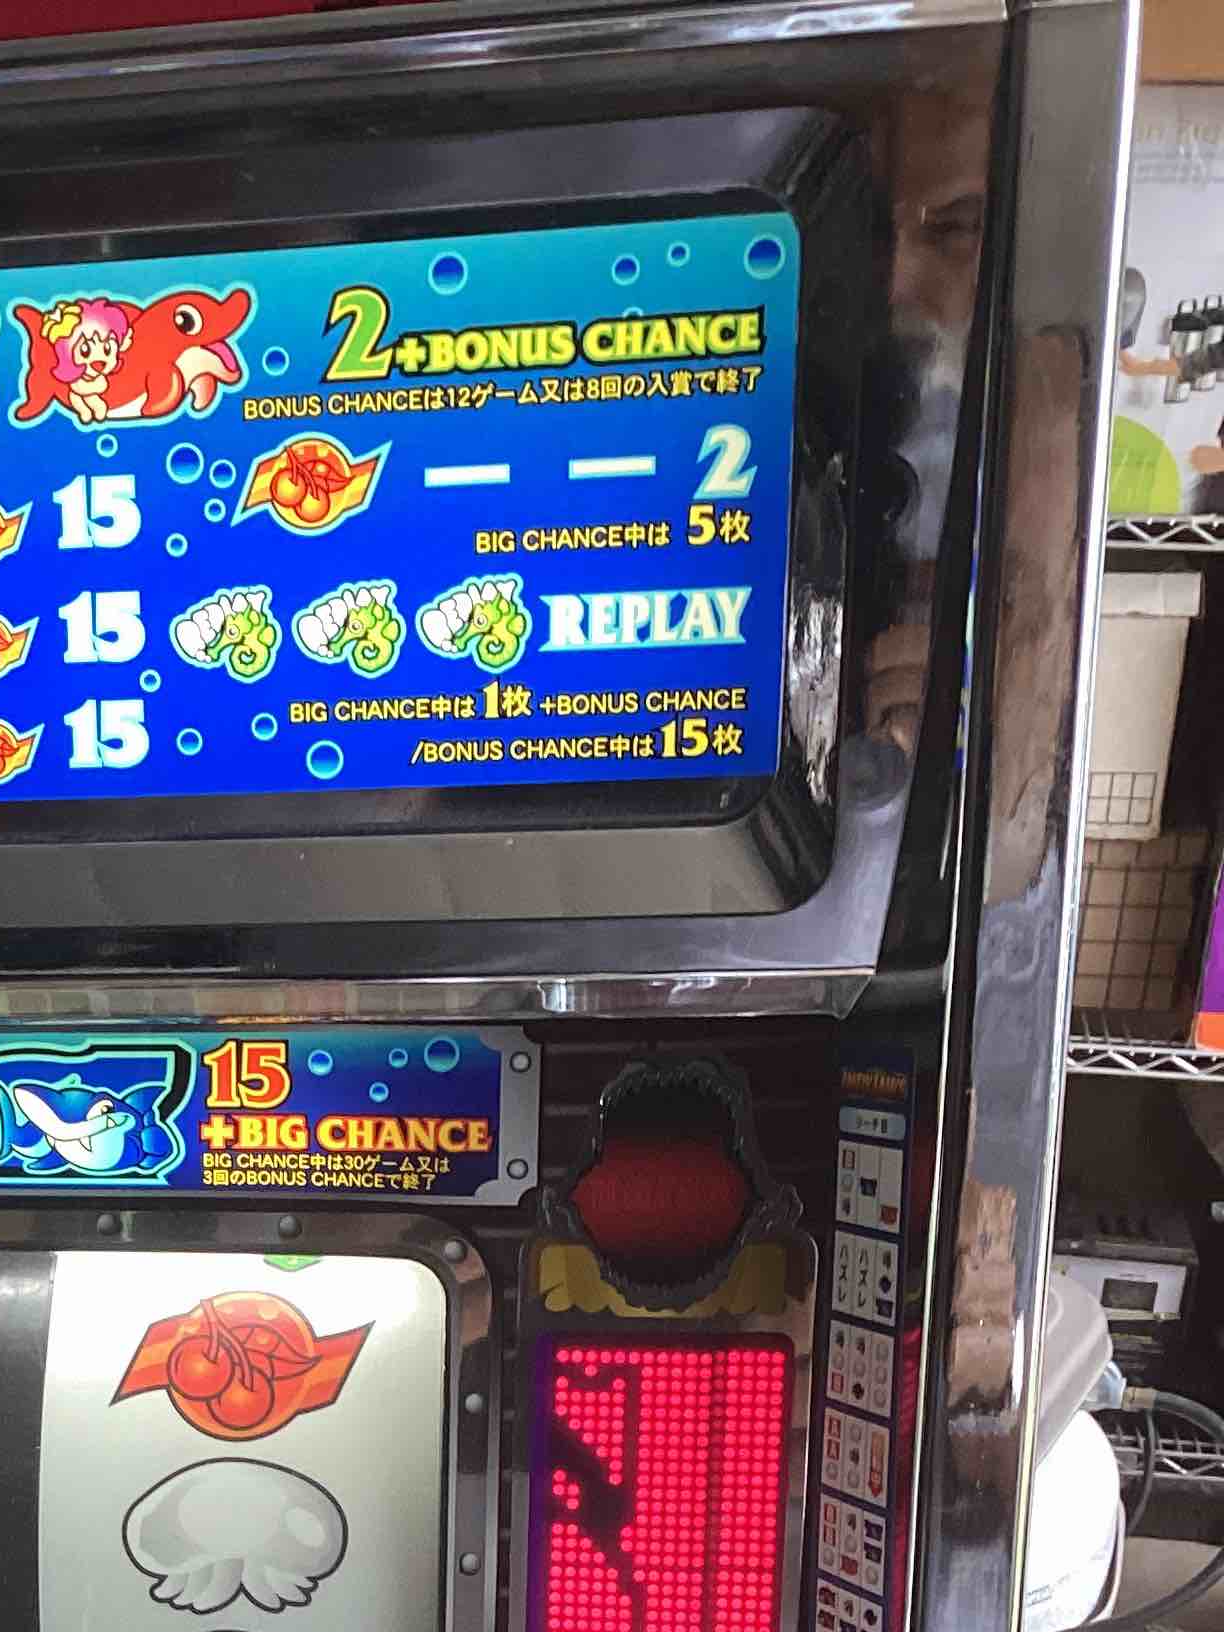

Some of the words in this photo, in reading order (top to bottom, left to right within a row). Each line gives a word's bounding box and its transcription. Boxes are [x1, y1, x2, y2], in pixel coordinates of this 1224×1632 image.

[321, 284, 392, 382] 2
[582, 308, 765, 365] CHANCE
[244, 394, 321, 420] BONUS
[694, 423, 758, 499] 2
[53, 475, 140, 549] 15
[476, 531, 515, 554] BIG
[59, 591, 144, 664] 15
[539, 587, 751, 651] REPLAY
[65, 700, 149, 769] 15
[290, 700, 327, 723] BIG
[645, 687, 746, 711] CHANCE
[203, 1040, 291, 1108] 15
[203, 1153, 232, 1169] BIG
[316, 1114, 492, 1152] CHANCE
